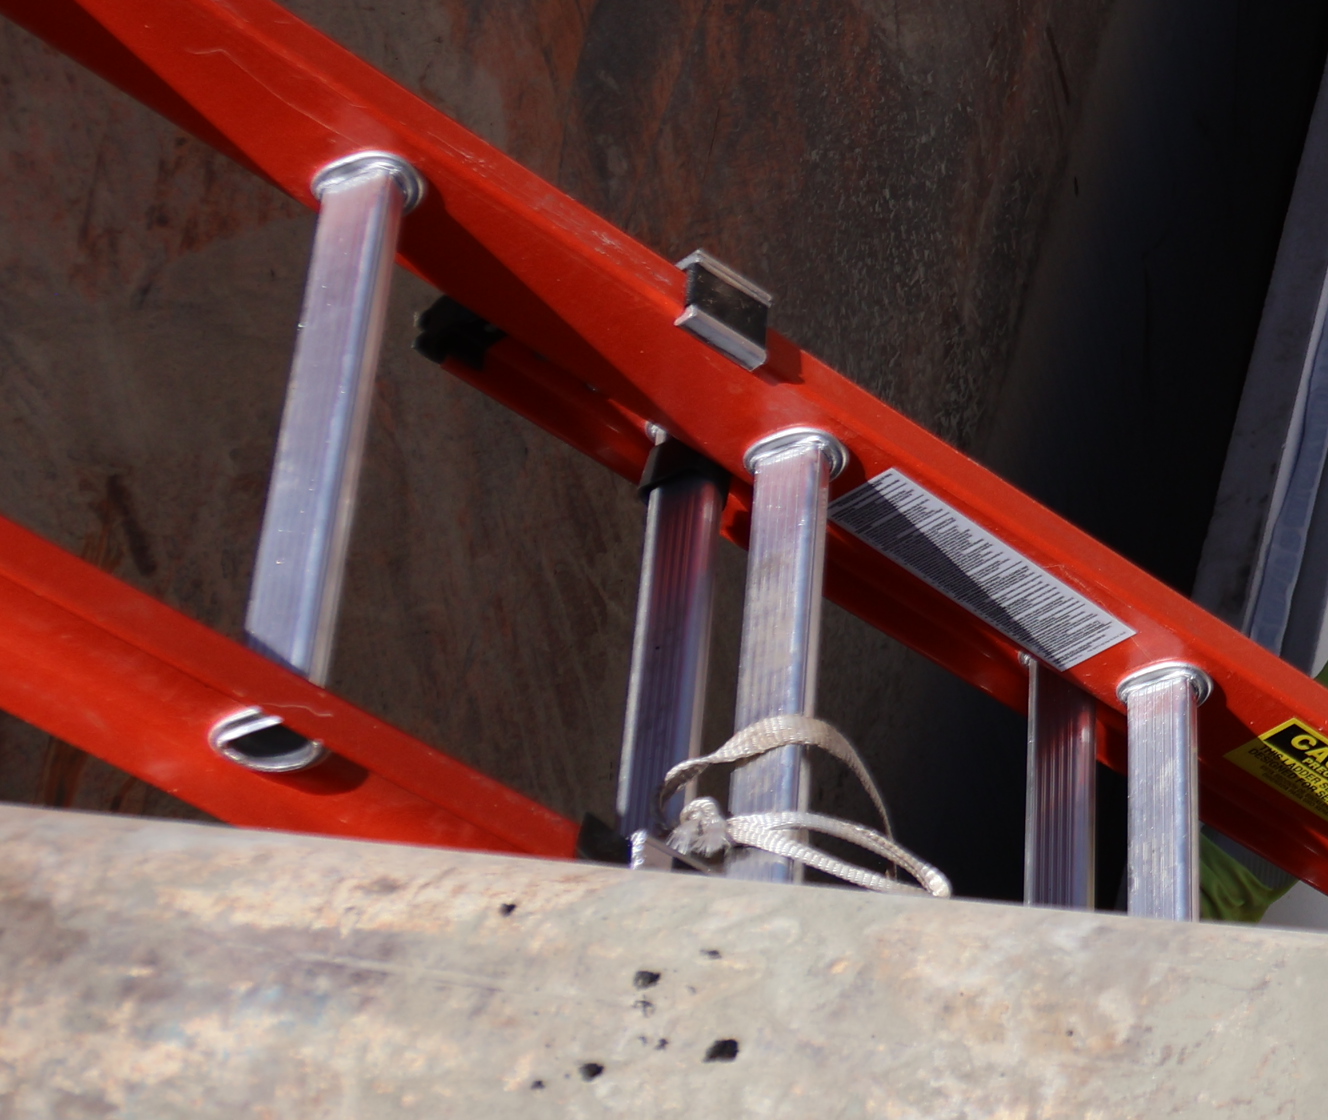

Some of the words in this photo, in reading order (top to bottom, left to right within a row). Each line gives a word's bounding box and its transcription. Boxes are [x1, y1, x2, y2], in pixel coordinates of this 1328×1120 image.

[1247, 747, 1298, 780] DESIGNED
[1295, 777, 1317, 792] FOR
[1259, 744, 1283, 761] THIS
[1280, 758, 1321, 785] LADDER
